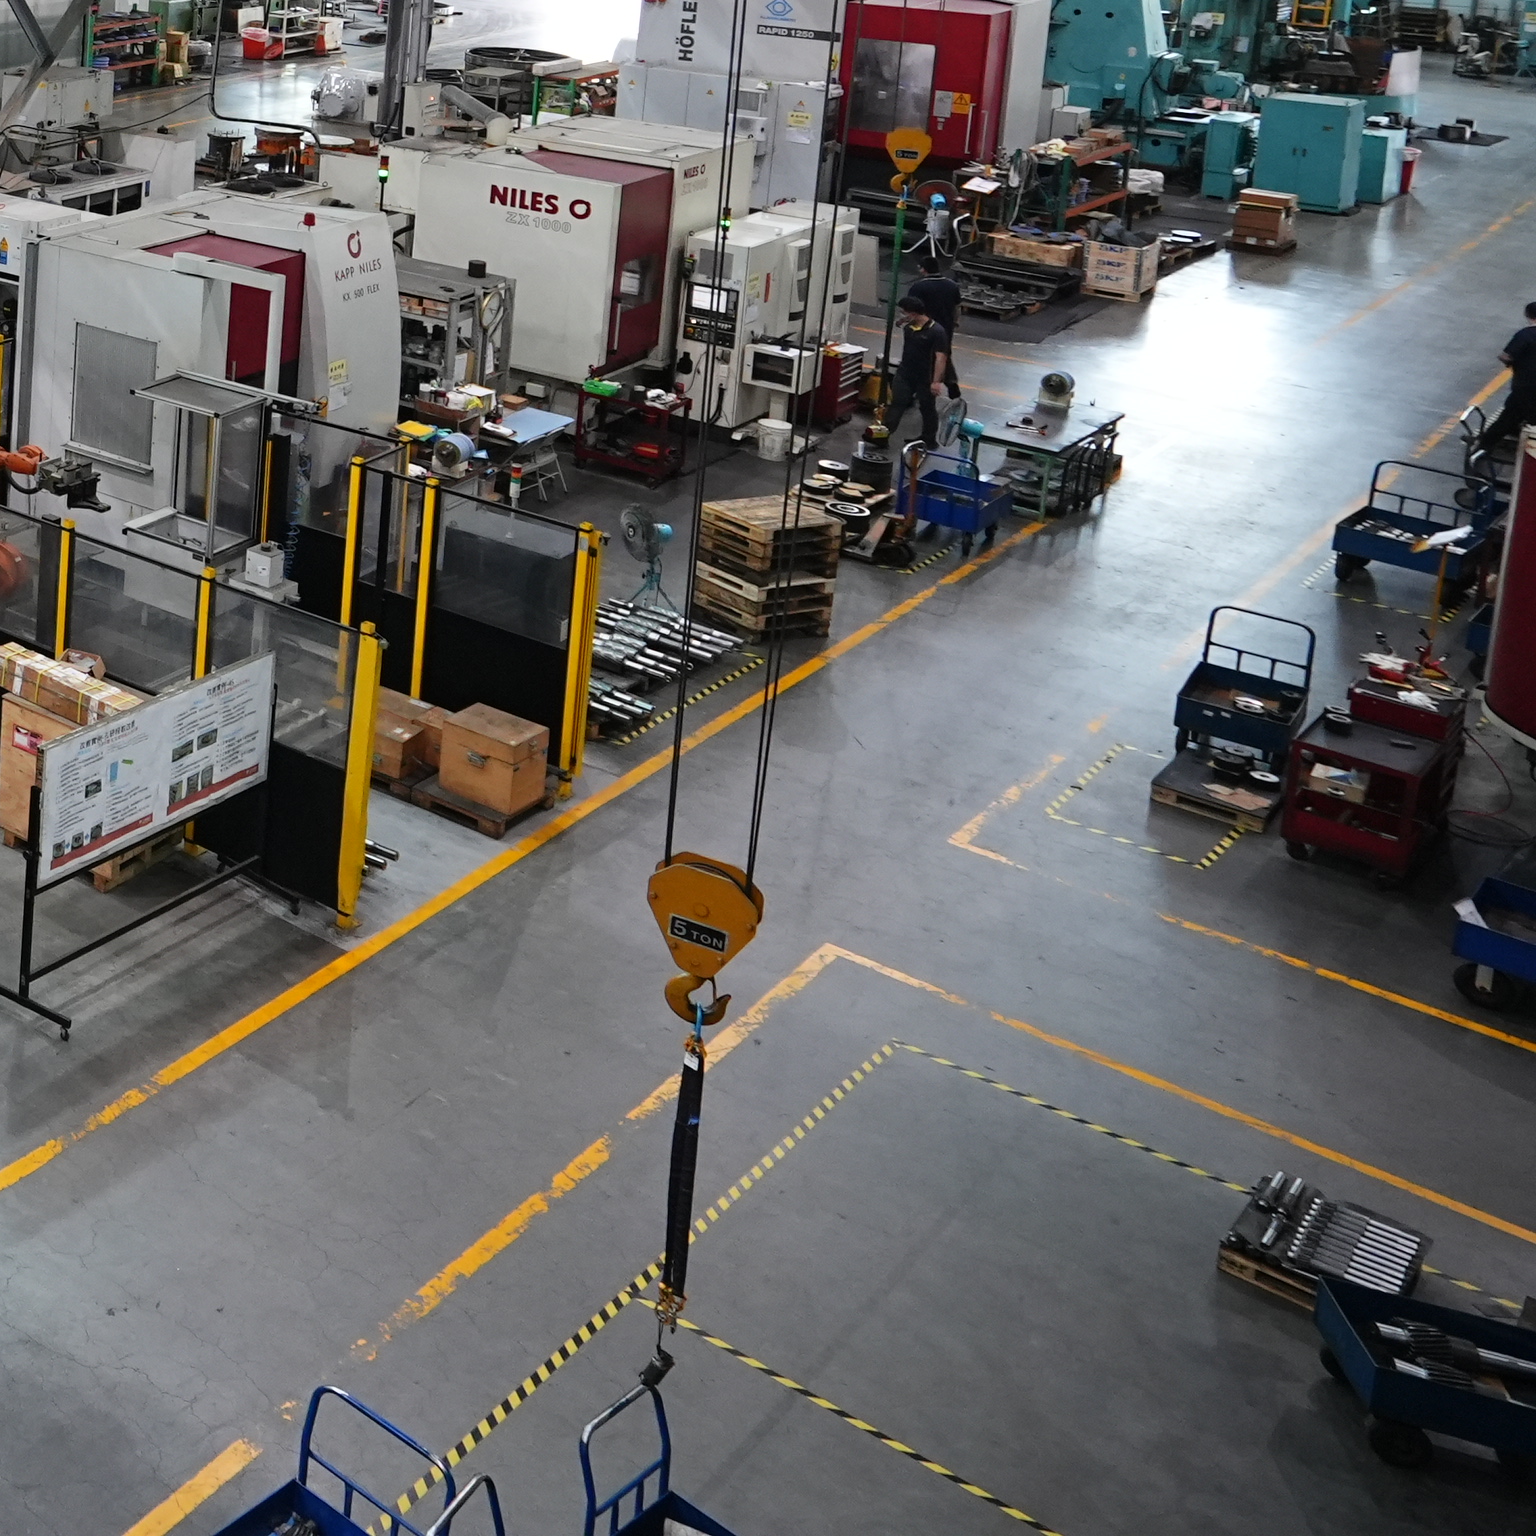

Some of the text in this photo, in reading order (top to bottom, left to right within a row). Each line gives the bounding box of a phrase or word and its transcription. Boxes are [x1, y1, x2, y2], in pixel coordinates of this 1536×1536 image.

[758, 26, 815, 39] RAPID 1250
[683, 166, 699, 180] NILES
[489, 184, 560, 215] NILES
[505, 210, 572, 234] ZX 1000
[334, 258, 382, 283] KAPP NILES
[367, 283, 380, 295] FLEX
[673, 920, 723, 949] 5 TON
